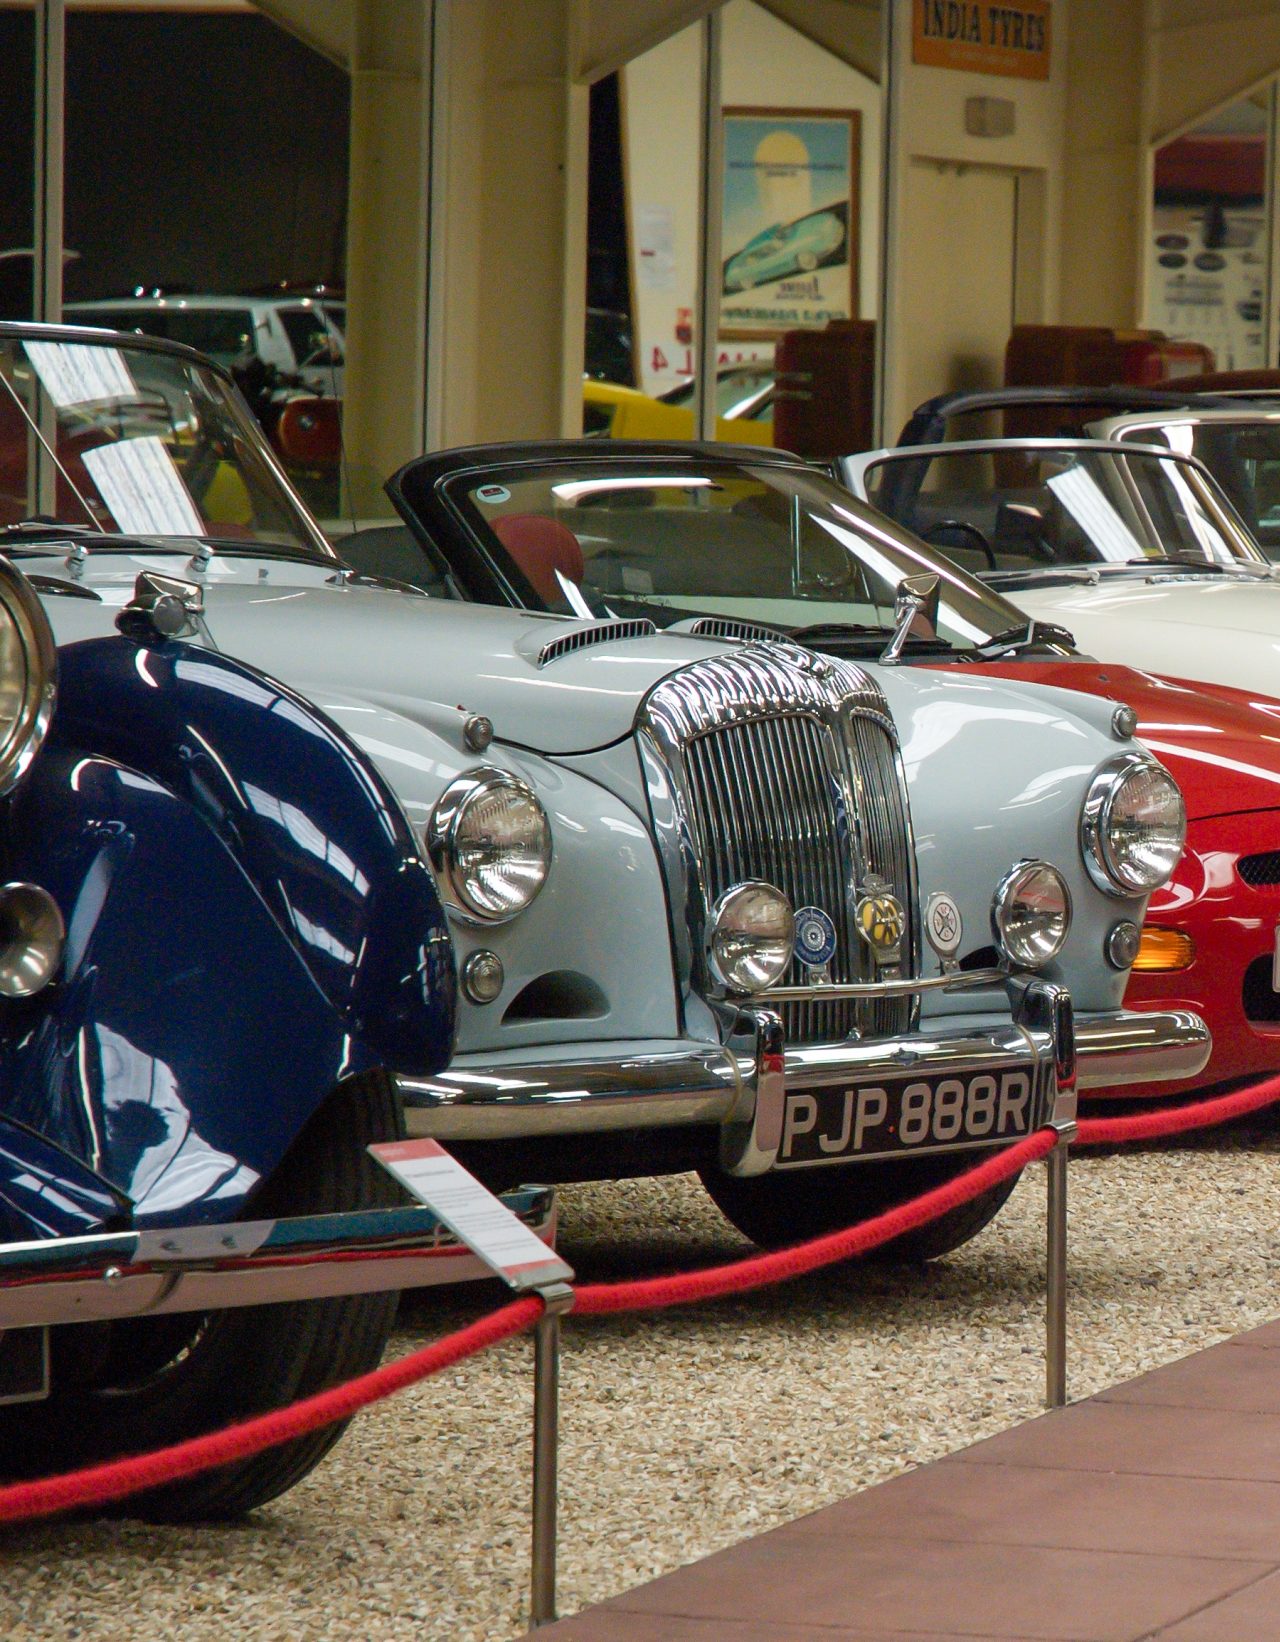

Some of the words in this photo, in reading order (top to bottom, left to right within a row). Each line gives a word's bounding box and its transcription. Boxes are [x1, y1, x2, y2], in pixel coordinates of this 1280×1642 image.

[922, 0, 981, 43] INDIA
[988, 6, 1045, 53] TYRES
[782, 1087, 888, 1158] PJP
[899, 1072, 1030, 1145] 888R
